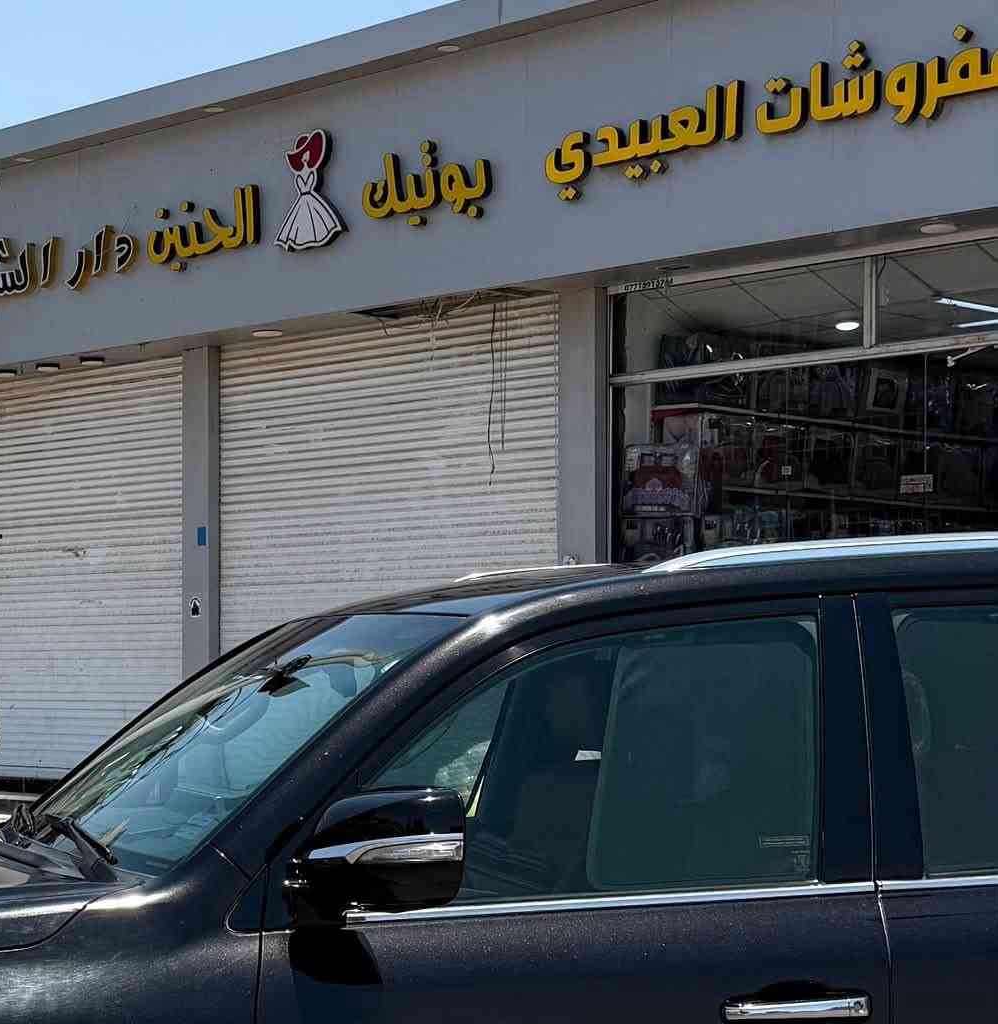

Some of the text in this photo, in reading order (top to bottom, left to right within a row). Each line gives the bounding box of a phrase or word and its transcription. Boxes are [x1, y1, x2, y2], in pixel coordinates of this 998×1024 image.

[545, 25, 998, 201] فروشات العبيدي
[66, 225, 137, 291] دار
[147, 140, 490, 272] بوتيك الحنين
